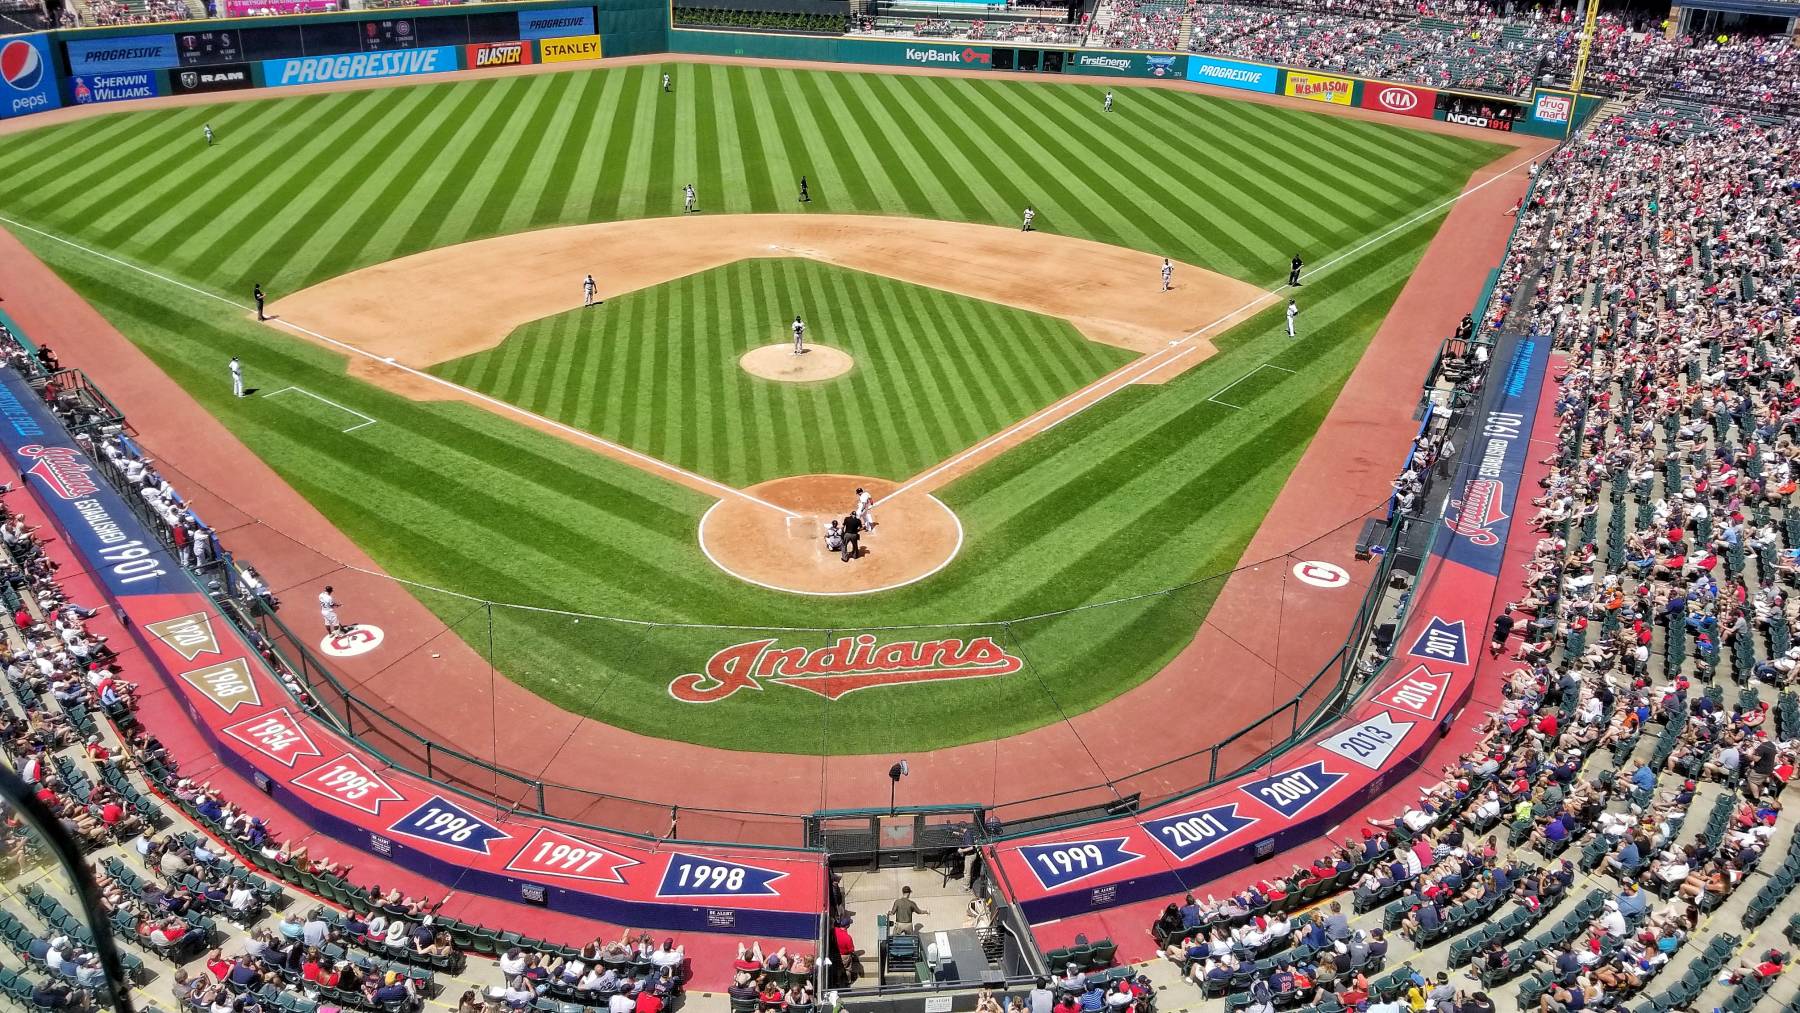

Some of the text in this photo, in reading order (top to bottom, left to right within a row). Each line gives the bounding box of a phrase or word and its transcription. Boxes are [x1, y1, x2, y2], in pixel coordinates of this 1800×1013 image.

[529, 16, 585, 31] PROGRESSIVE
[85, 46, 163, 63] PROGRESSIVE
[477, 46, 521, 66] BLASTER
[544, 42, 597, 56] STANLEY
[906, 48, 960, 63] KeyBank
[1080, 56, 1131, 69] FirstEnergy
[94, 74, 147, 88] SHERWIN
[201, 71, 244, 83] RAM
[281, 49, 439, 84] PROGRESSIVE
[1199, 64, 1263, 84] PROGRESSIVE
[12, 91, 48, 112] pepsi
[94, 88, 151, 101] WILLIAMS
[1386, 91, 1411, 106] KIA
[1540, 96, 1564, 112] drug
[1446, 112, 1511, 131] NOCO 1914
[1540, 110, 1567, 121] mart
[1483, 411, 1524, 440] 1901
[1478, 438, 1509, 478] ESTABLISHED
[73, 498, 129, 543] ESTABLISHED
[99, 540, 167, 584] 1901
[166, 614, 209, 646] 1920
[1425, 625, 1460, 658] 2017
[202, 667, 249, 697] 1948
[668, 634, 1024, 704] Indians
[1392, 678, 1438, 710] 2016
[246, 718, 301, 751] 1954
[1340, 725, 1393, 758] 2013
[317, 765, 380, 800] 1995
[1260, 771, 1320, 808] 2007
[414, 807, 482, 842] 1996
[1162, 812, 1230, 848] 2001
[532, 841, 604, 873] 1997
[1037, 844, 1104, 876] 1999
[678, 863, 745, 891] 1998
